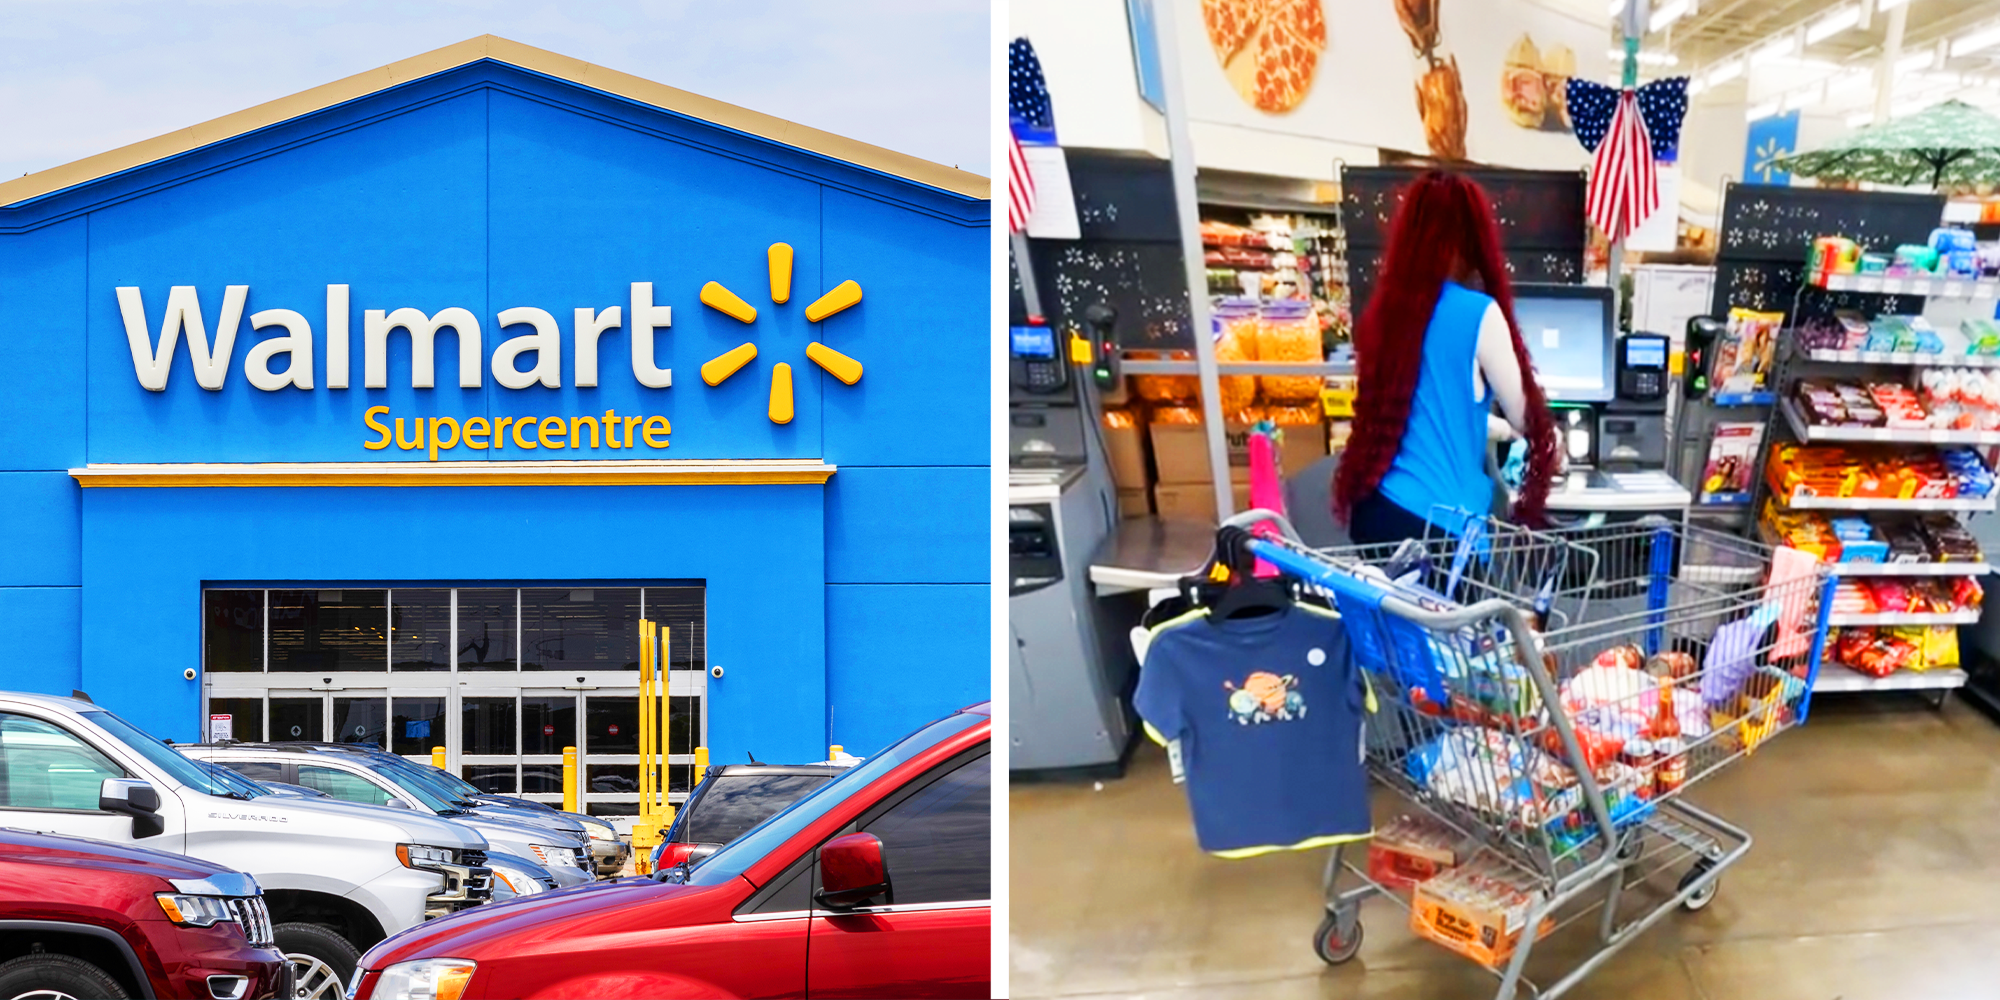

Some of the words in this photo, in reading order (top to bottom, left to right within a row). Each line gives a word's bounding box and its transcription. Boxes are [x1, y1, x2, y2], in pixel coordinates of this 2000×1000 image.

[115, 282, 672, 391] Walmart
[364, 405, 672, 460] Supercentre
[208, 812, 288, 823] SILVERADO
